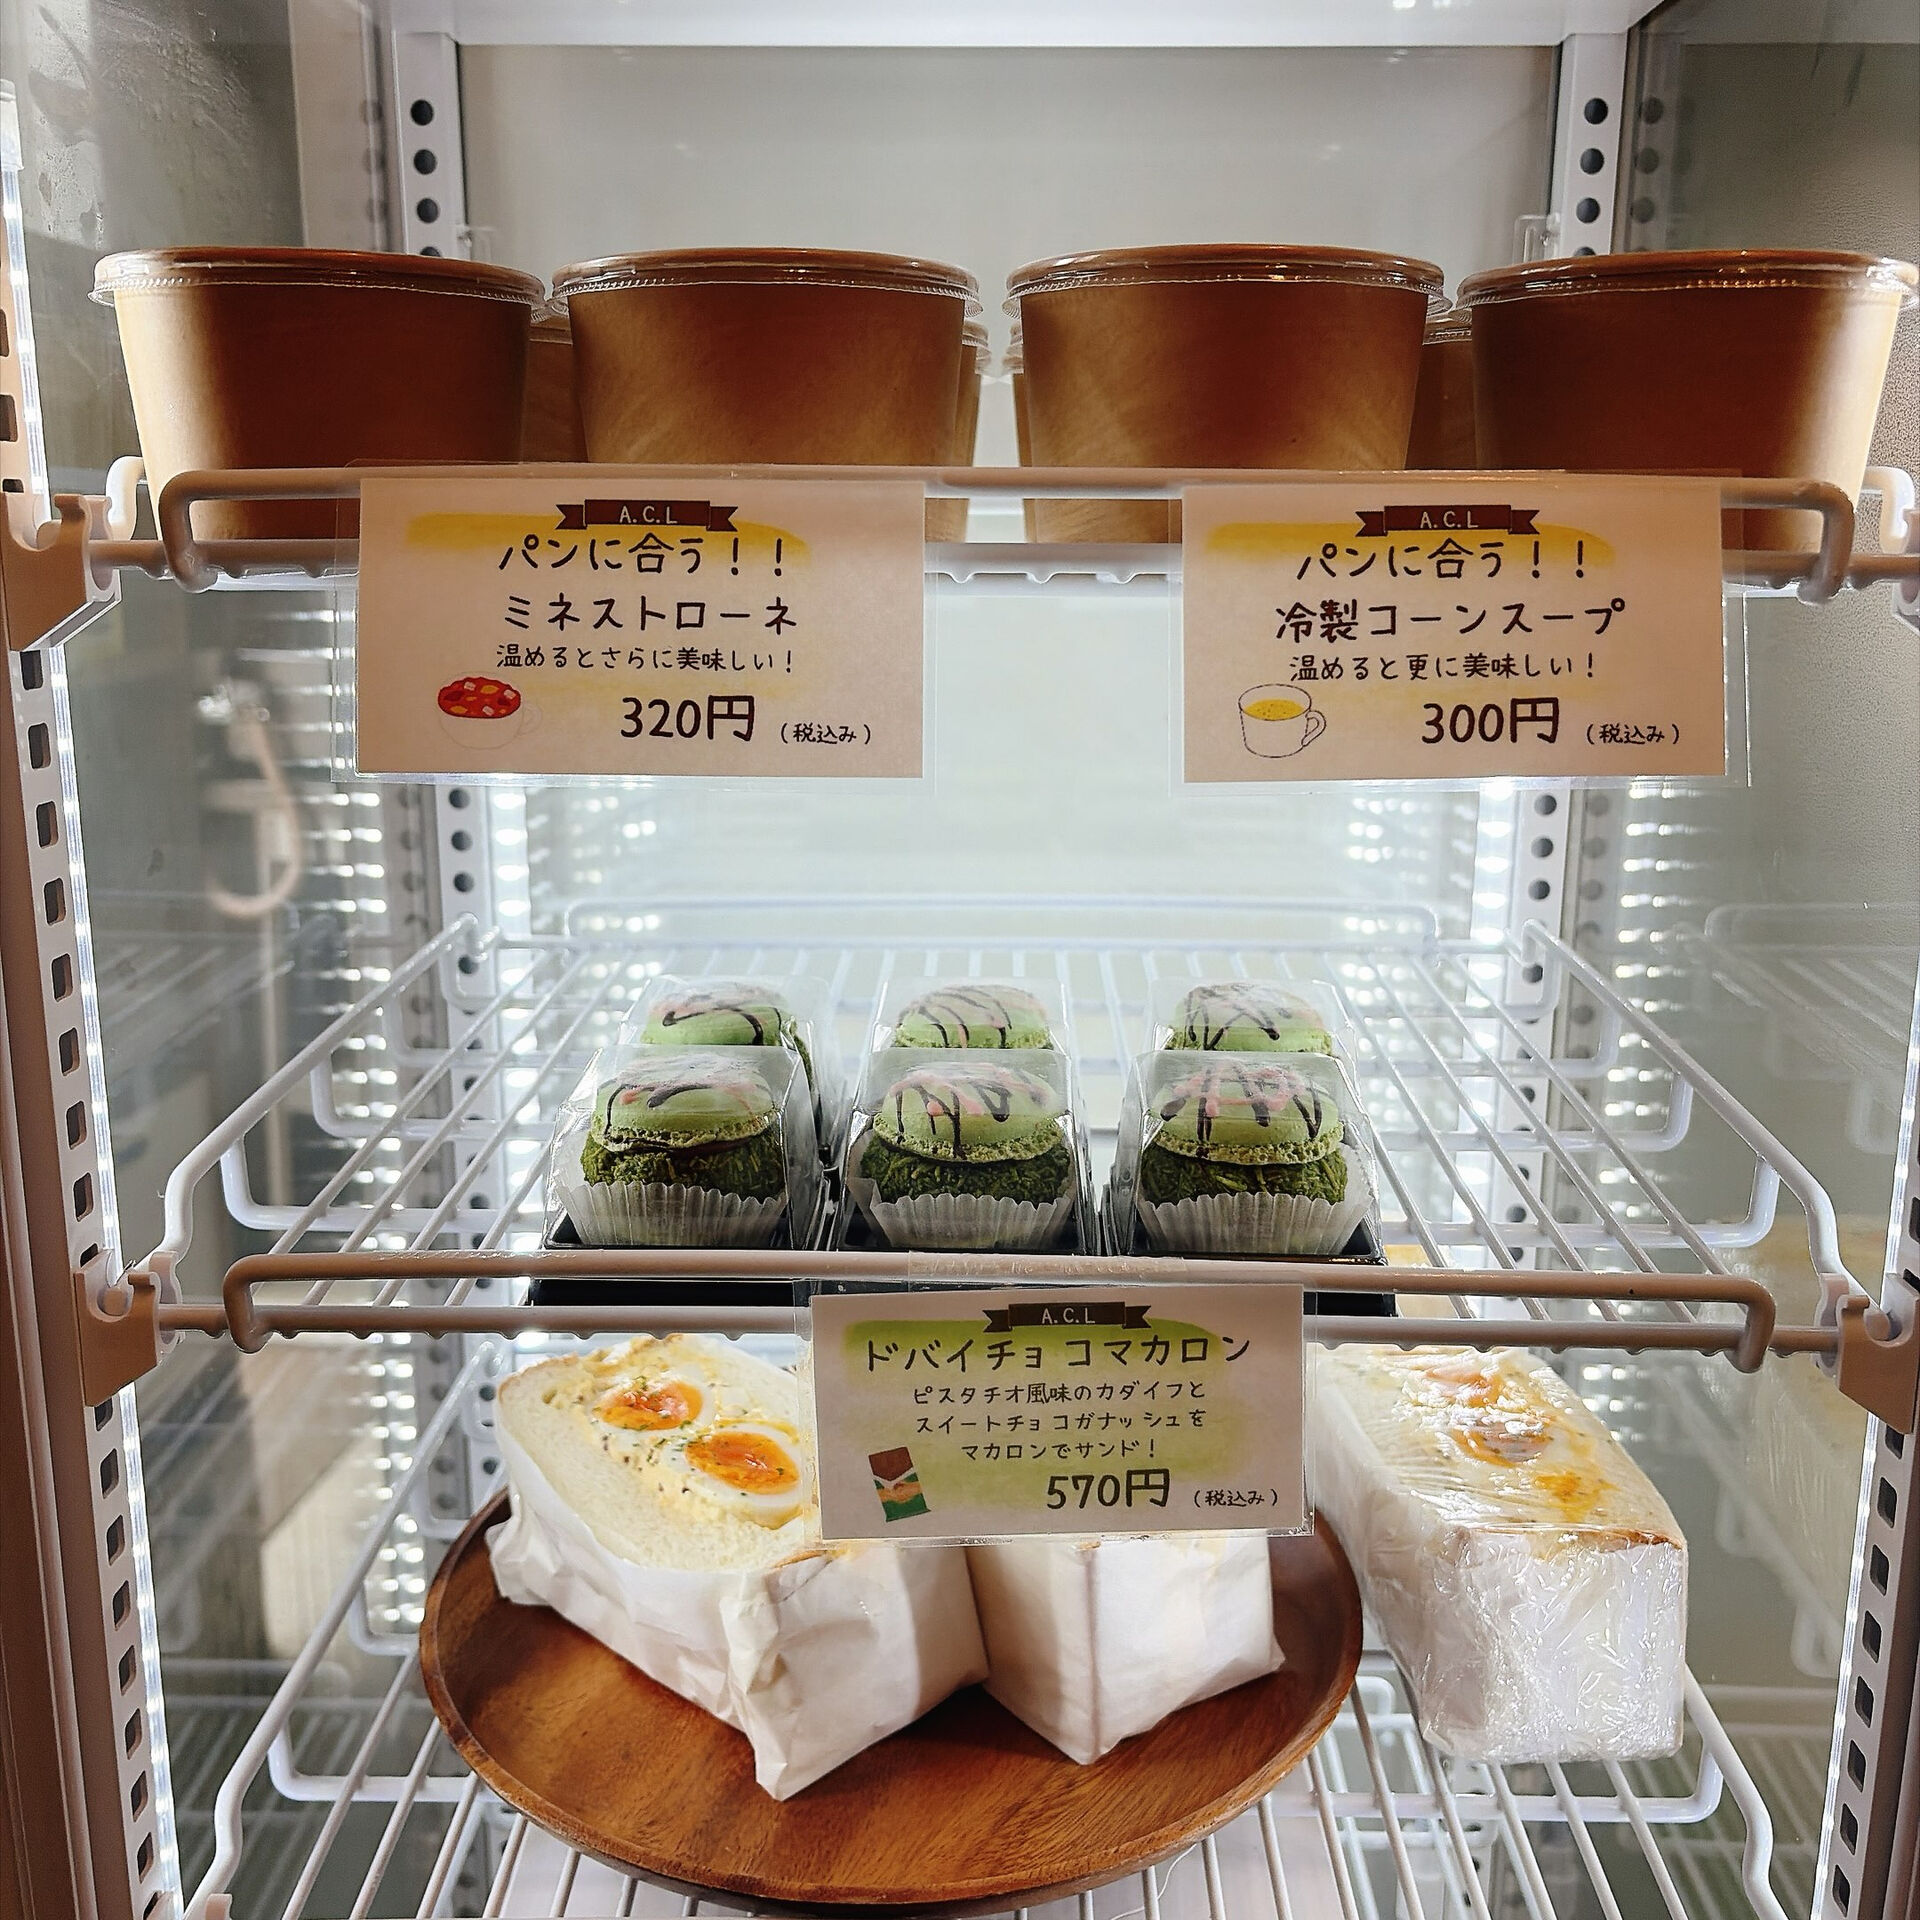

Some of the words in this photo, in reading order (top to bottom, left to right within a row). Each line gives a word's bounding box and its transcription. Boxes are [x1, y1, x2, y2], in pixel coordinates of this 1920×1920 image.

[618, 506, 678, 524] A.C.L
[1419, 511, 1479, 529] A.C.L
[498, 533, 783, 577] パンに合う！！
[1297, 538, 1585, 581] パンに合う！！
[503, 592, 798, 635] ミネストローネ
[1275, 598, 1626, 643] 冷製コーンスープ
[496, 643, 793, 673] 温めるとさらに美味しい！
[1289, 652, 1595, 681] 温めると更に美味しい！
[620, 694, 755, 742] 320円
[781, 723, 872, 746] （税込み）
[1421, 696, 1560, 745] 300円
[1586, 723, 1680, 746] （税込み）
[1041, 1308, 1096, 1326] A.C.L
[866, 1335, 1251, 1373] ドバイチョコマカロン
[913, 1380, 1205, 1405] ピスタチオ風味のカダイフと
[916, 1408, 1207, 1435] スイートチョコガナッシュを
[961, 1439, 1156, 1461] マカロンでサンド！
[1046, 1468, 1170, 1509] 570円
[1194, 1488, 1279, 1508] （税込み）
